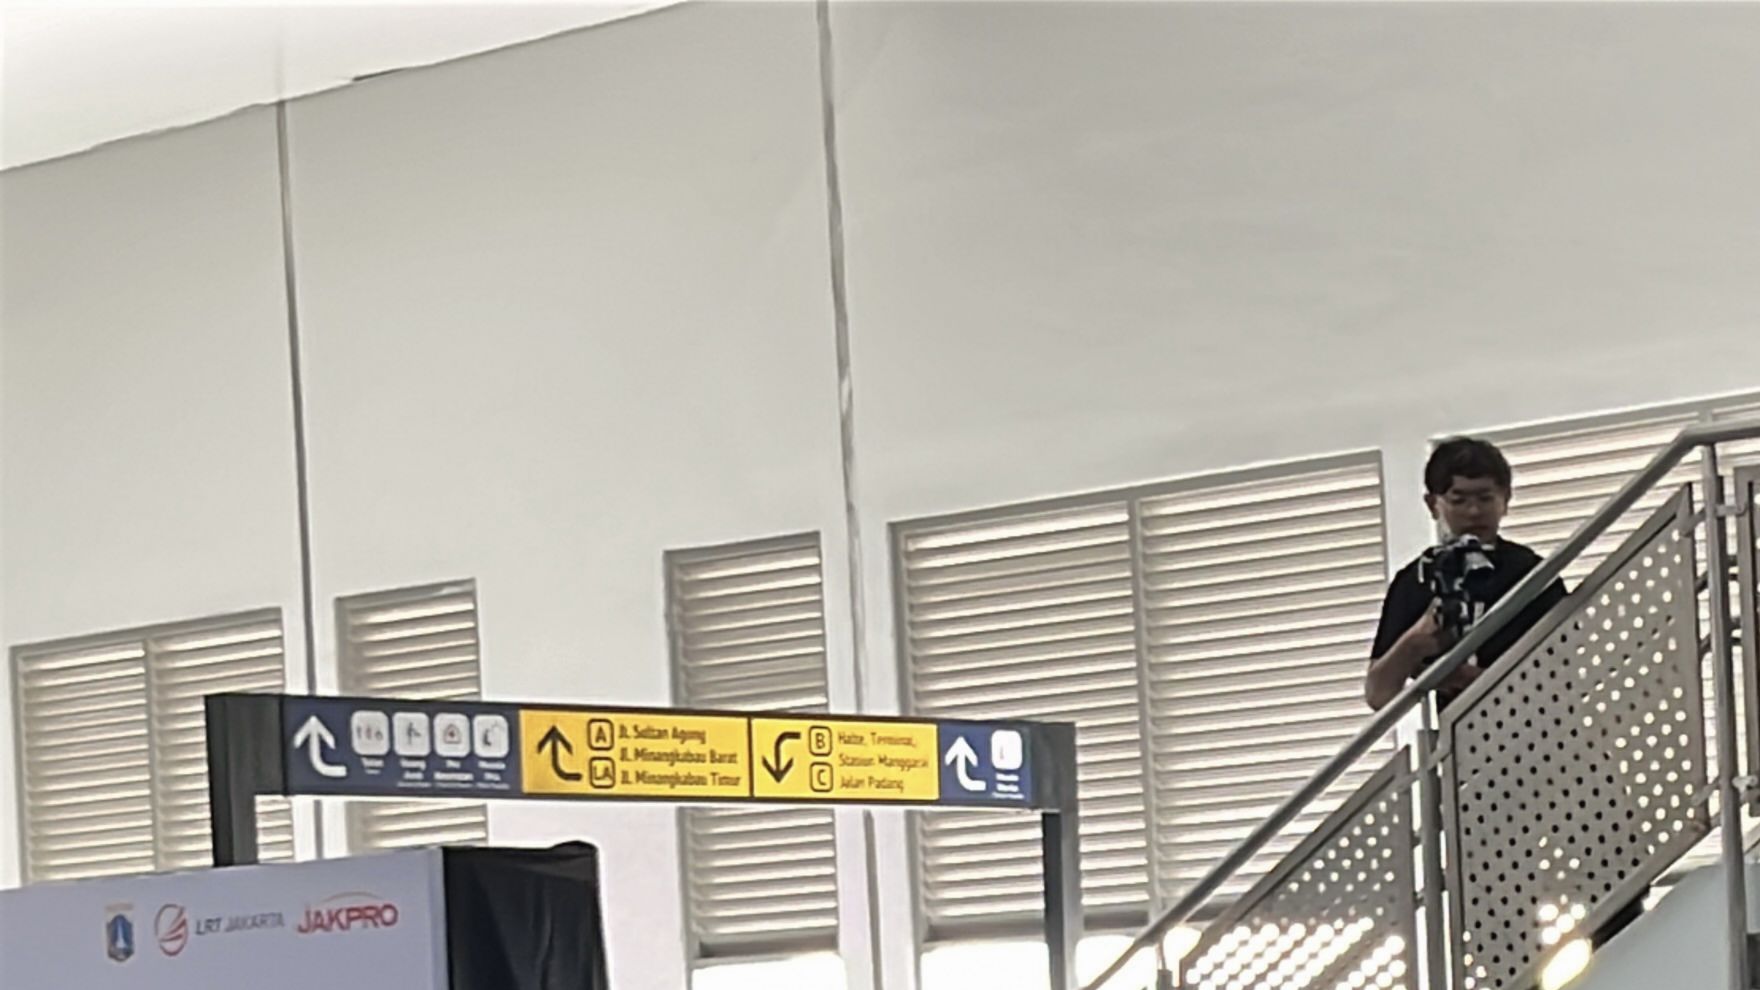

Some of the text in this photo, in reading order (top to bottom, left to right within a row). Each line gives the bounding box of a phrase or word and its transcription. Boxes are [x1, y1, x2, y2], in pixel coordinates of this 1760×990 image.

[595, 726, 607, 743] A
[815, 732, 826, 750] B
[593, 765, 613, 781] LA
[817, 769, 827, 786] C
[195, 911, 285, 936] LRT JAKARTA
[297, 903, 399, 935] JAKPRO
